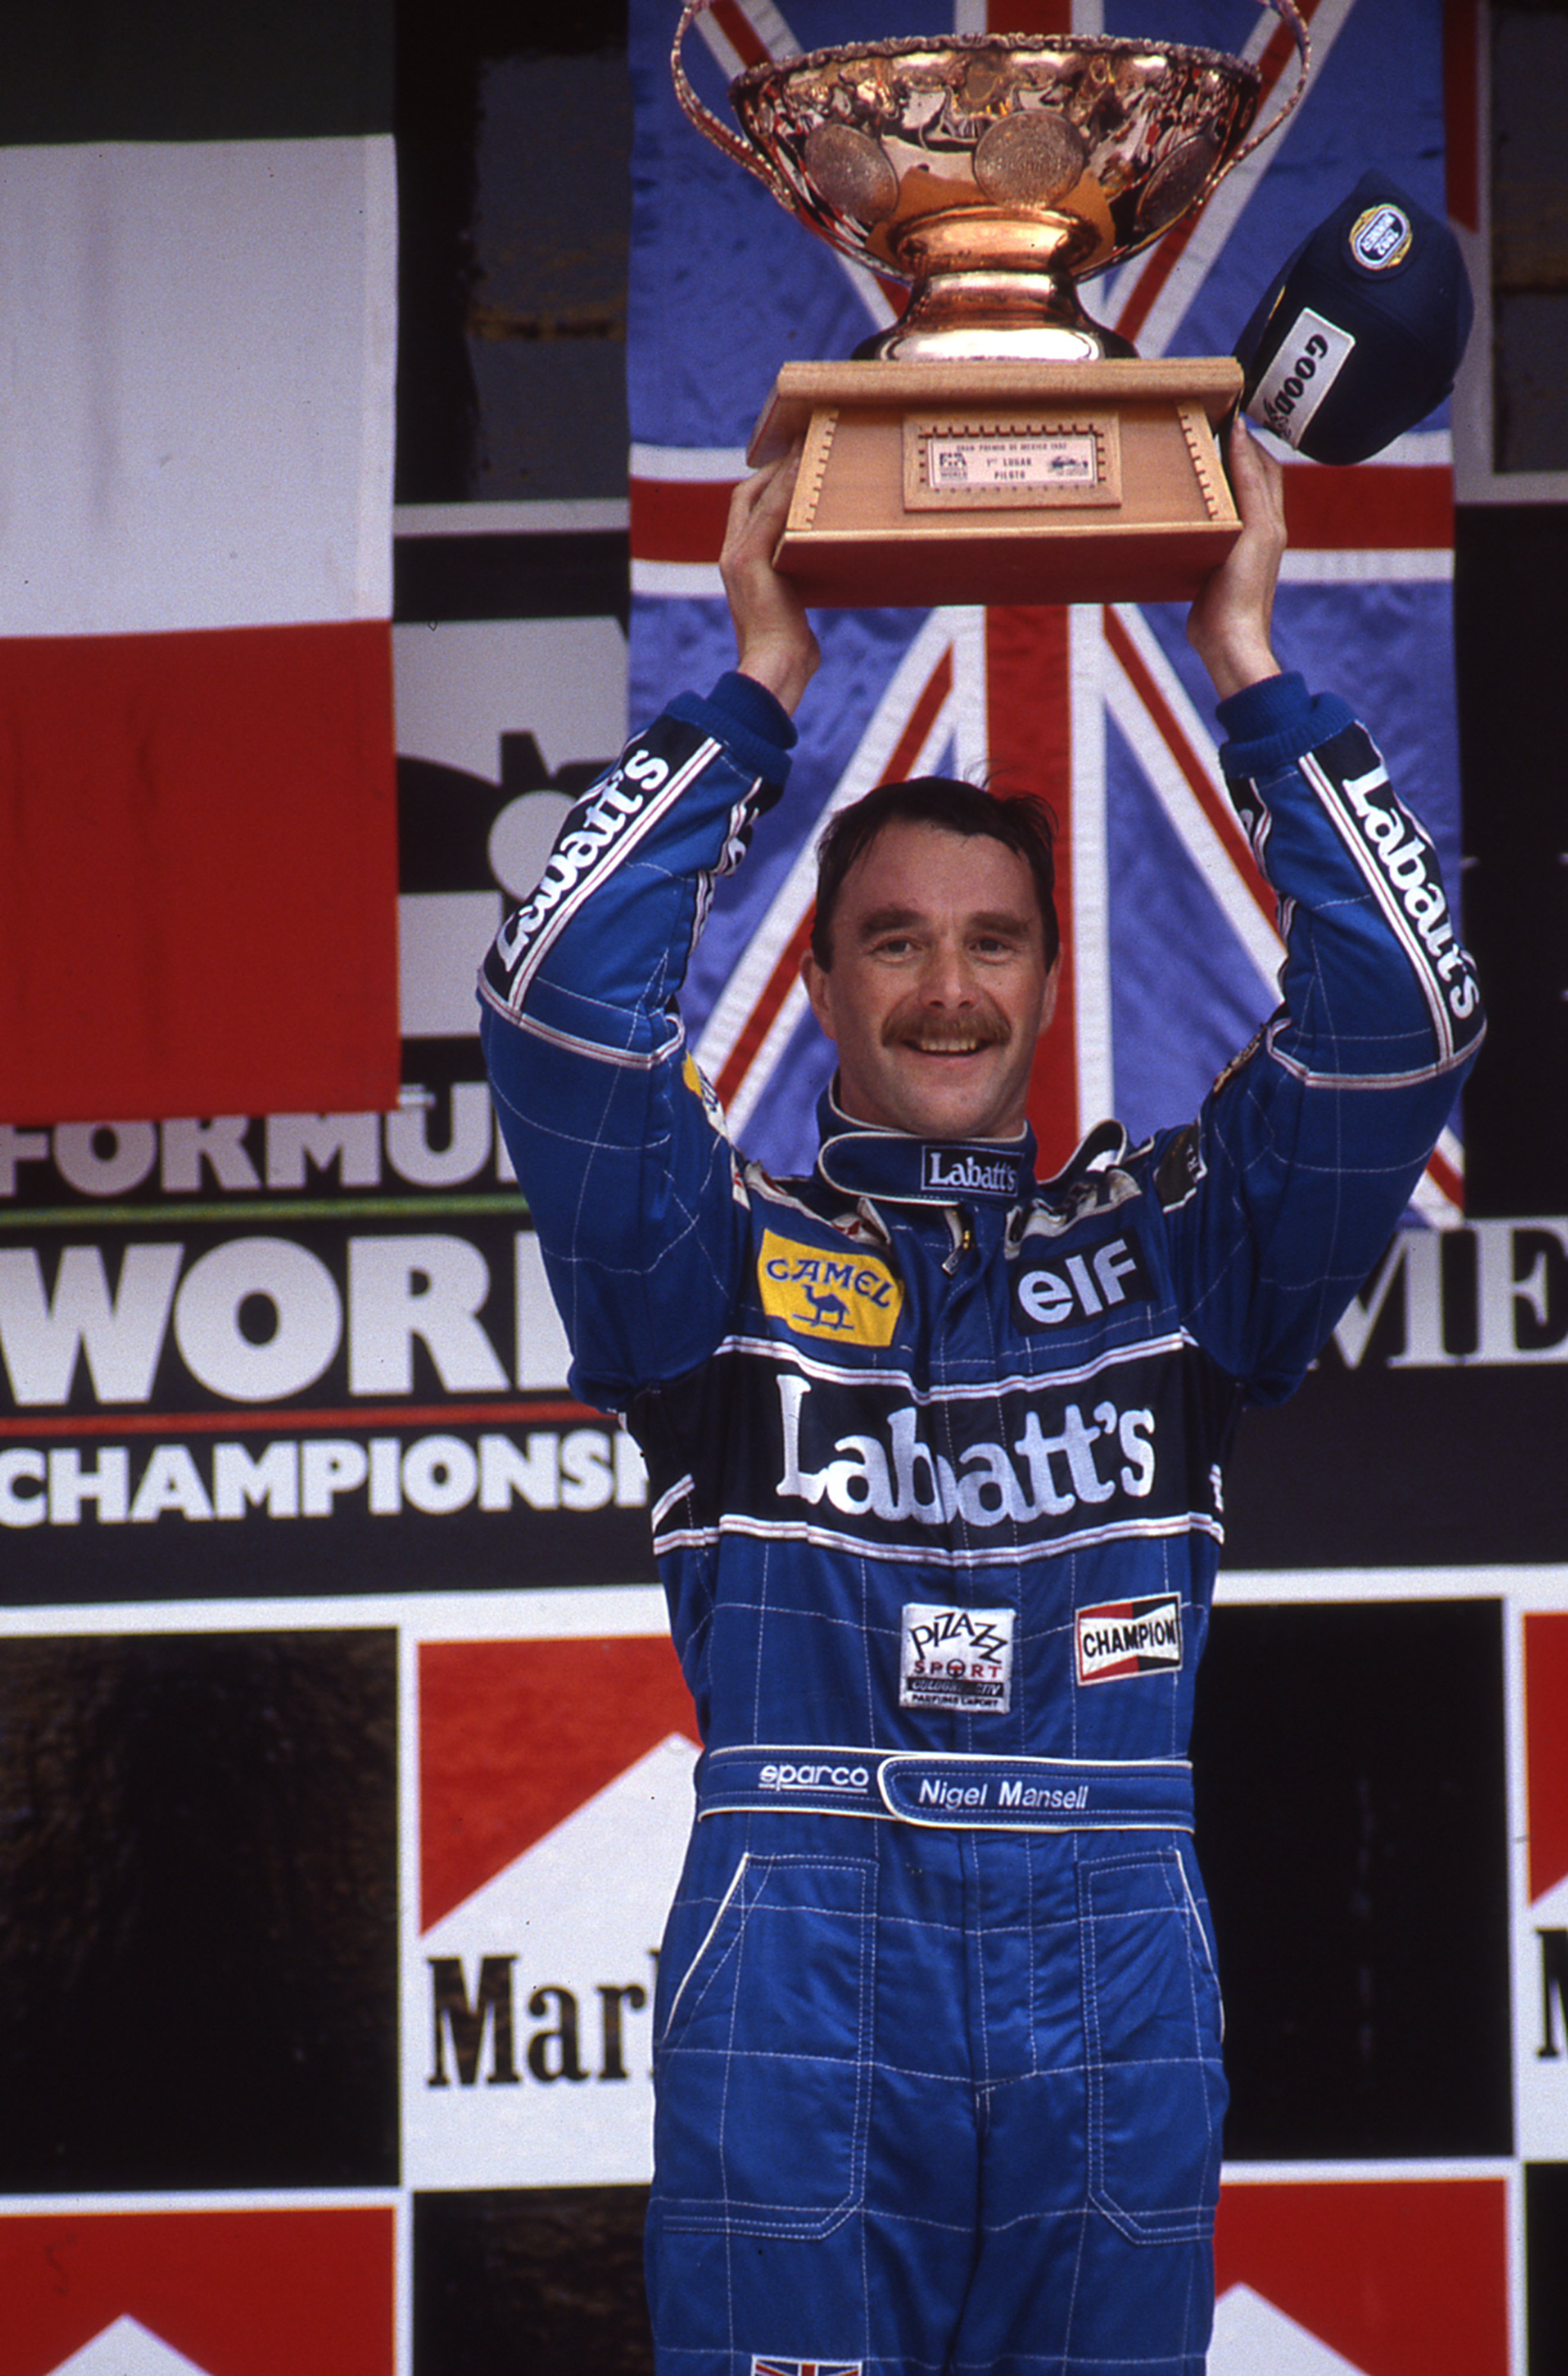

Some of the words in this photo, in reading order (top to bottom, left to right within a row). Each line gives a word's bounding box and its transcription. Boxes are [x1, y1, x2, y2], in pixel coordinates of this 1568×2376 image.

[929, 1152, 1017, 1192] Labatt's
[766, 1257, 893, 1309] CAMEL
[1018, 1238, 1137, 1325] elf
[776, 1373, 1154, 1527] Labatt's
[909, 1612, 1009, 1664] PIZAZZ
[1083, 1619, 1177, 1658] CHAMPION
[914, 1657, 1003, 1679] SPORT
[760, 1764, 869, 1792] sparco
[919, 1779, 988, 1811] Nigel
[998, 1780, 1089, 1809] Mansell
[426, 1949, 659, 2087] Mar
